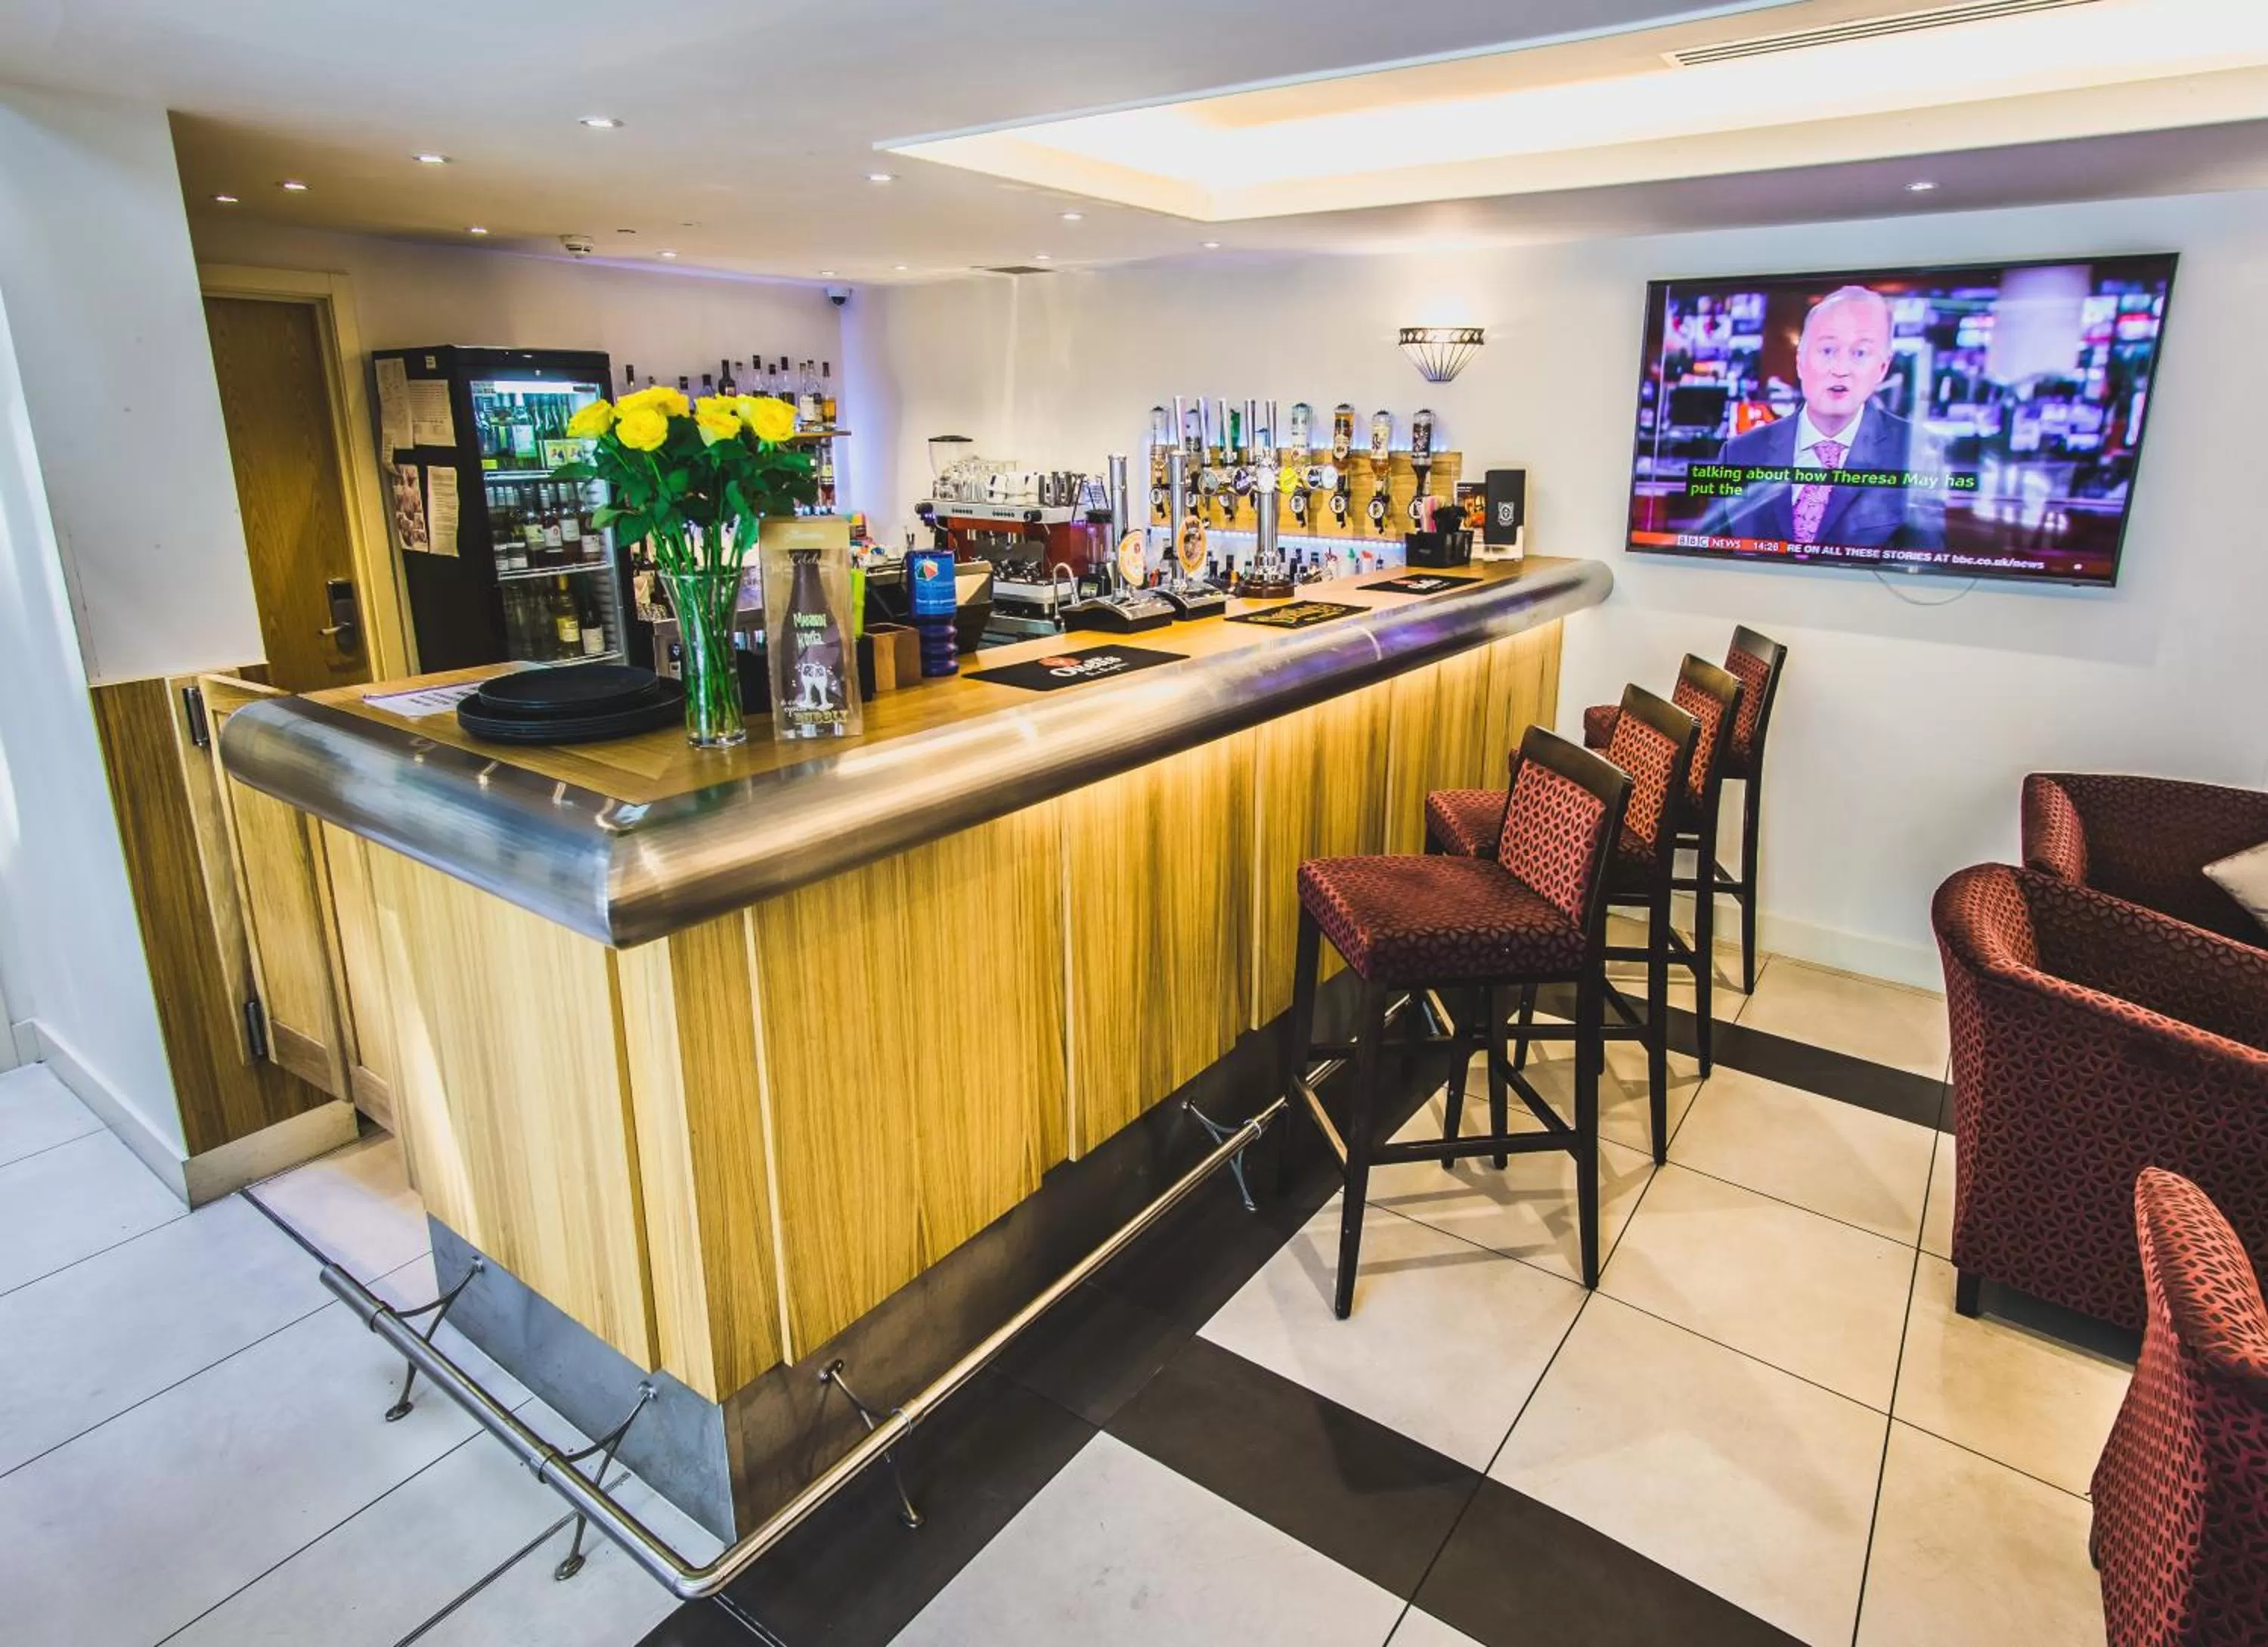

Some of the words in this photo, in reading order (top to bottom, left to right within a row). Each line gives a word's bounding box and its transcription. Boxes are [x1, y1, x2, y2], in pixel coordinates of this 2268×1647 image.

[1692, 465, 1742, 481] talking
[1746, 468, 1790, 480] about
[1795, 468, 1827, 482] how
[1832, 470, 1897, 485] Theresa
[1902, 472, 1938, 489] May
[1944, 473, 1975, 488] has
[1690, 482, 1715, 496] put
[1719, 482, 1743, 495] the
[1678, 535, 1709, 547] BBC
[1712, 538, 1740, 548] NEWS
[1787, 544, 1802, 554] RE
[1804, 544, 1820, 554] ON
[1821, 546, 1842, 556] ALL
[1845, 547, 1880, 558] THESE
[1882, 550, 1932, 562] STORIES
[1934, 553, 1949, 563] AT
[1952, 554, 2045, 569] bbc.co.uk/news
